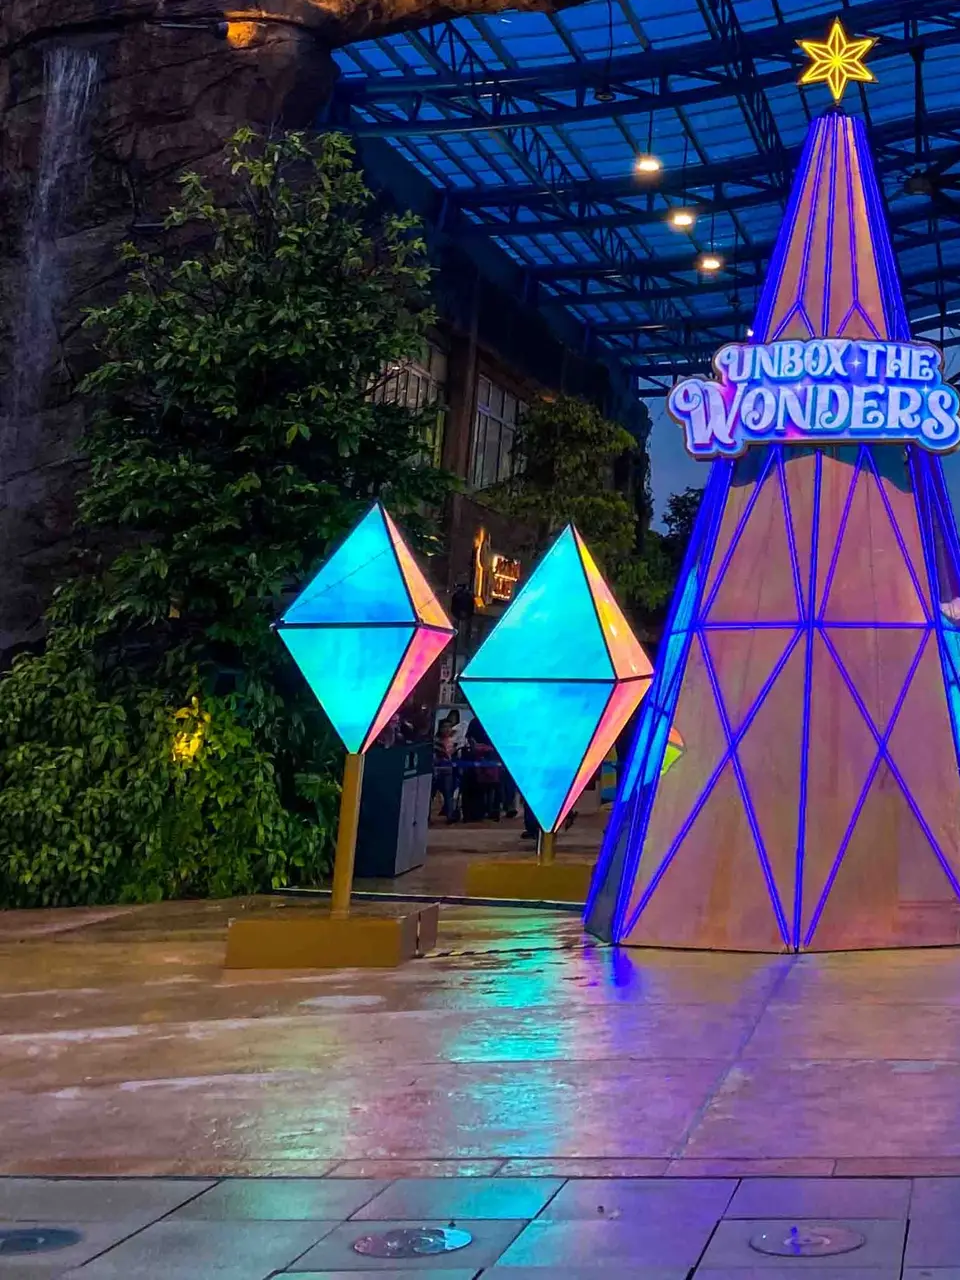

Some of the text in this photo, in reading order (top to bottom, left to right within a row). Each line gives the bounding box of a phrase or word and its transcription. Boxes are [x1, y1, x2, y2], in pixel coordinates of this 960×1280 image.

[716, 340, 937, 382] UNBOX THE
[673, 381, 957, 446] WONDERS
